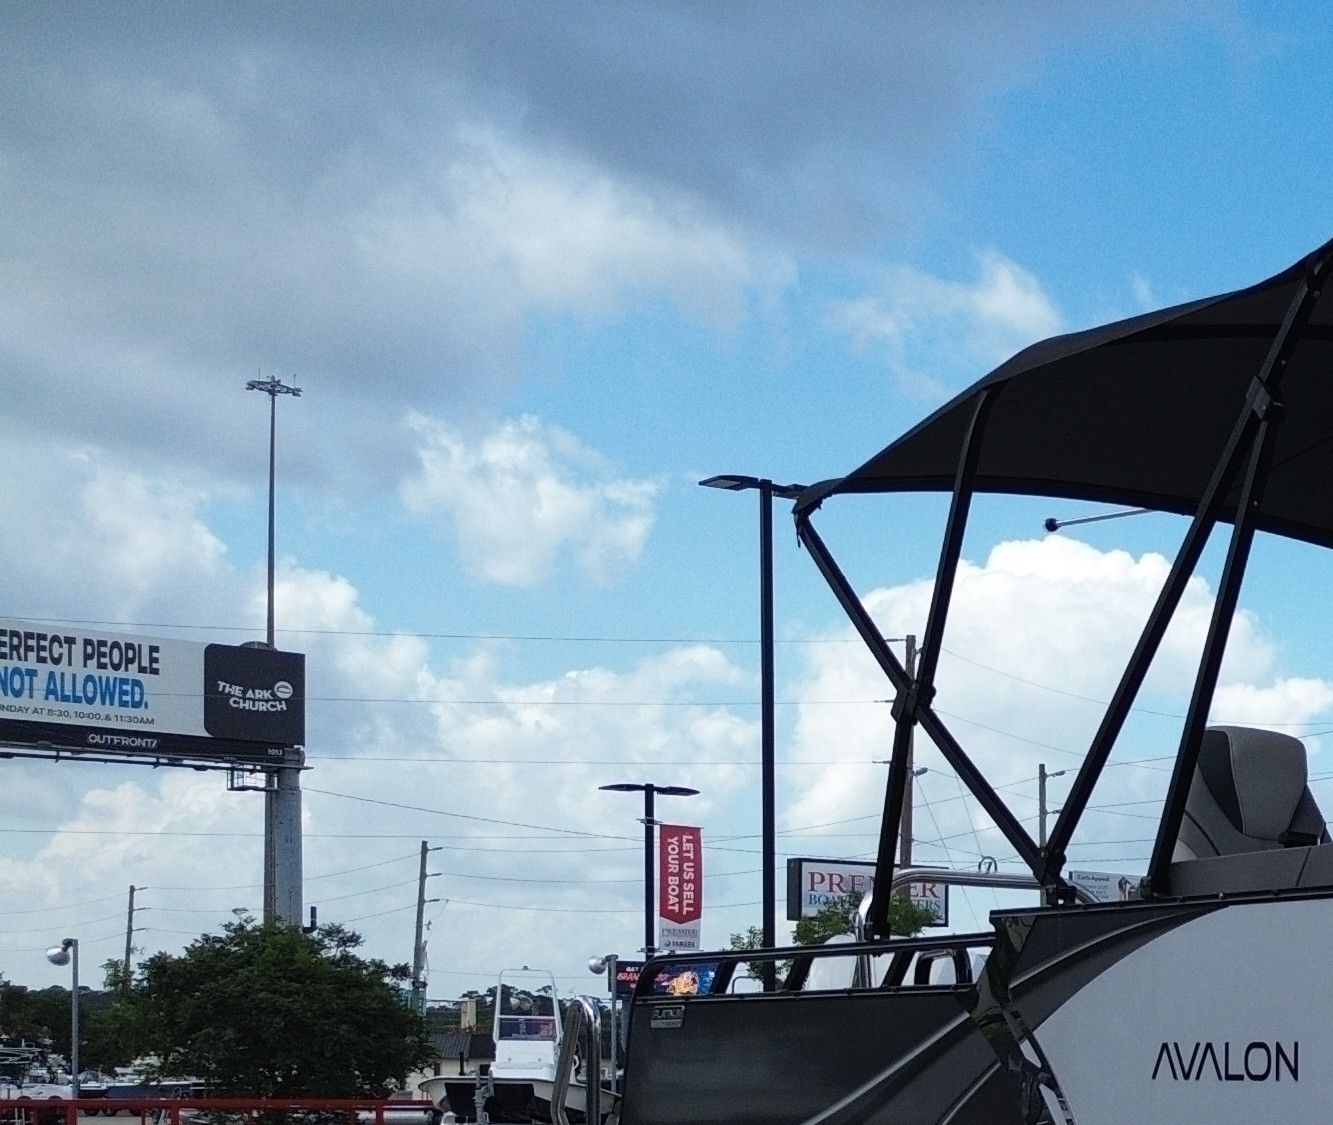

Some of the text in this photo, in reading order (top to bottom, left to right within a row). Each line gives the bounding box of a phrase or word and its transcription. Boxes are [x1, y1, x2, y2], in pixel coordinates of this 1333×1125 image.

[83, 638, 160, 675] PEOPLE
[0, 666, 149, 710] NOT ALLOWED.
[218, 681, 274, 700] THE ARK
[229, 697, 287, 712] CHURCH
[0, 704, 30, 714] NDAY
[32, 707, 45, 715] AT
[104, 713, 112, 721] &
[667, 836, 680, 913] YOUR BOAT
[682, 835, 695, 915] LET US SELL
[1152, 1041, 1299, 1081] AVALON
